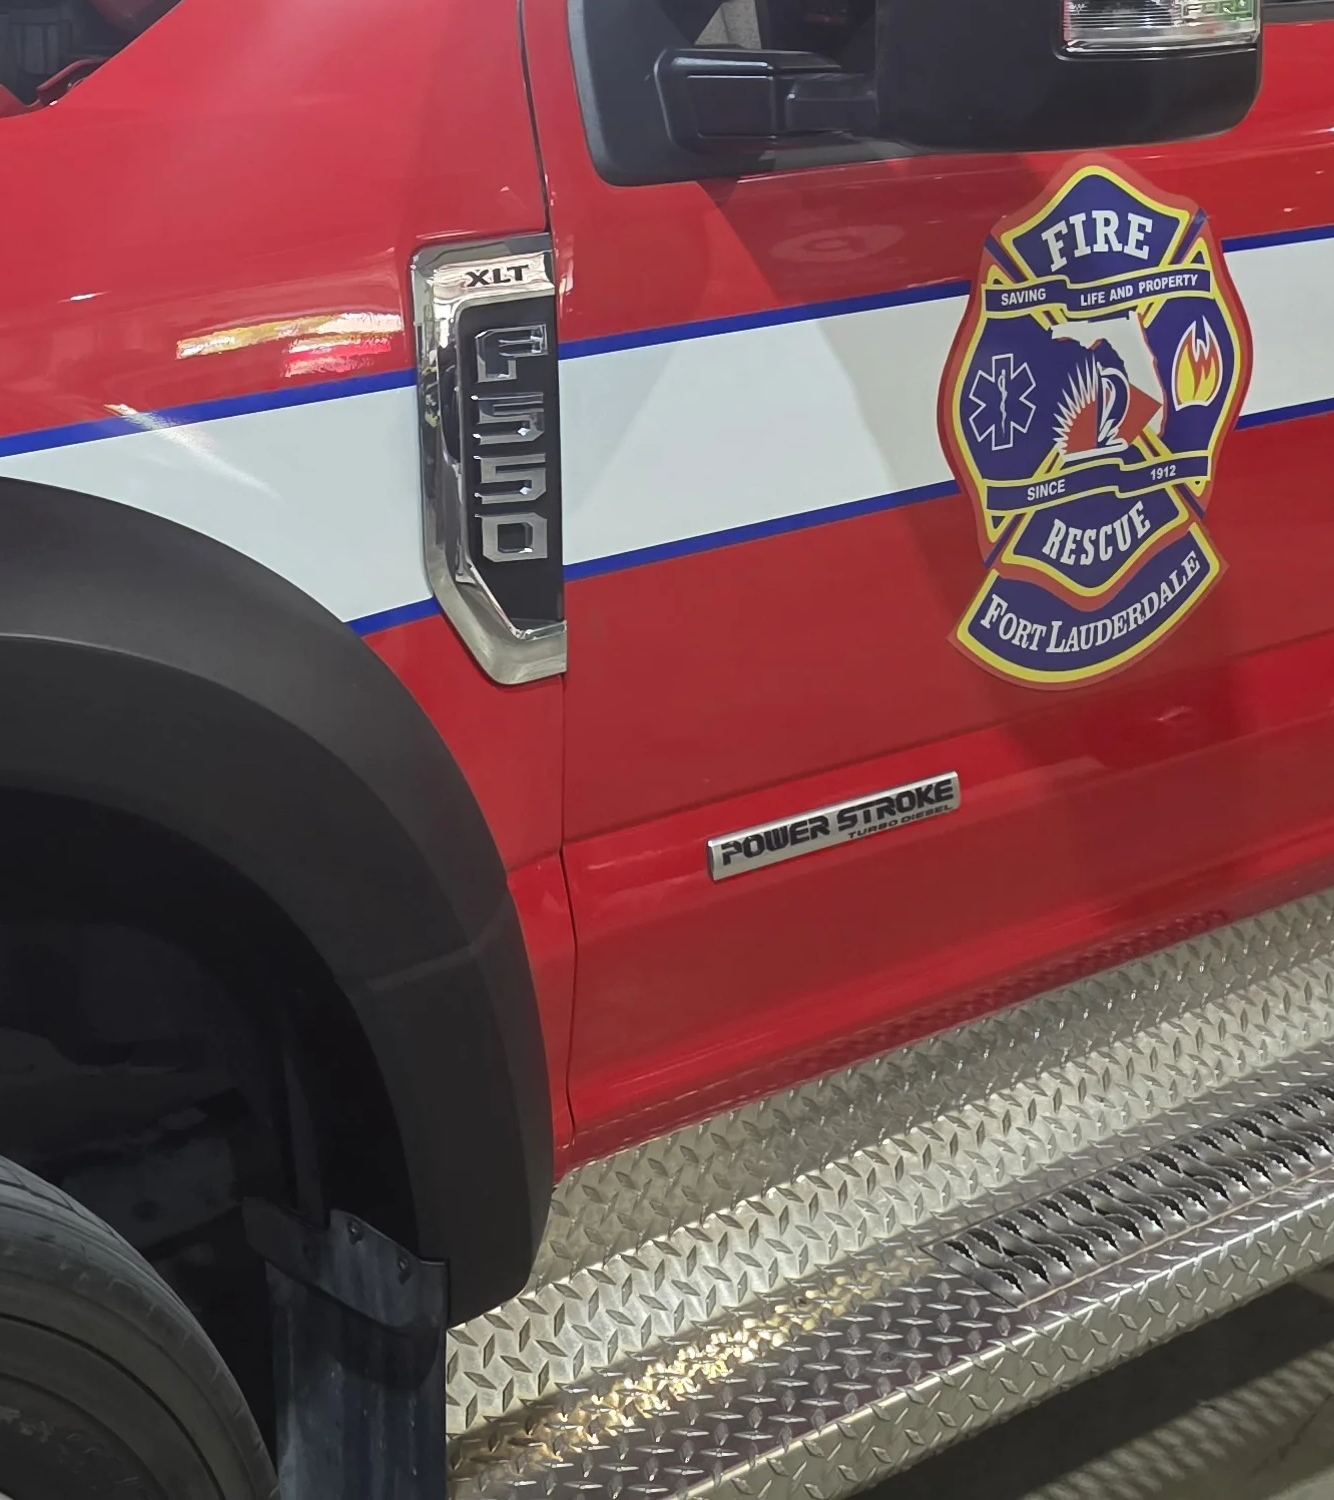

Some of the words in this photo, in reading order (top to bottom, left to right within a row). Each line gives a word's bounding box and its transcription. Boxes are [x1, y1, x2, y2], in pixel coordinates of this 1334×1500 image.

[1041, 210, 1153, 272] FIRE
[465, 264, 529, 287] XLT
[1001, 287, 1047, 306] SAVING
[1080, 291, 1106, 306] LIFE
[1109, 285, 1134, 302] AND
[1138, 274, 1199, 294] PROPERTY
[1027, 478, 1066, 501] SINCE
[1150, 464, 1177, 481] 1912
[1042, 500, 1151, 566] RESCUE
[980, 594, 1047, 651] FORT
[1046, 550, 1201, 653] LAUDERDALE
[721, 814, 831, 866] POWER
[836, 778, 954, 832] STROKE
[848, 819, 898, 839] TURBO
[901, 804, 954, 824] DIESEL
